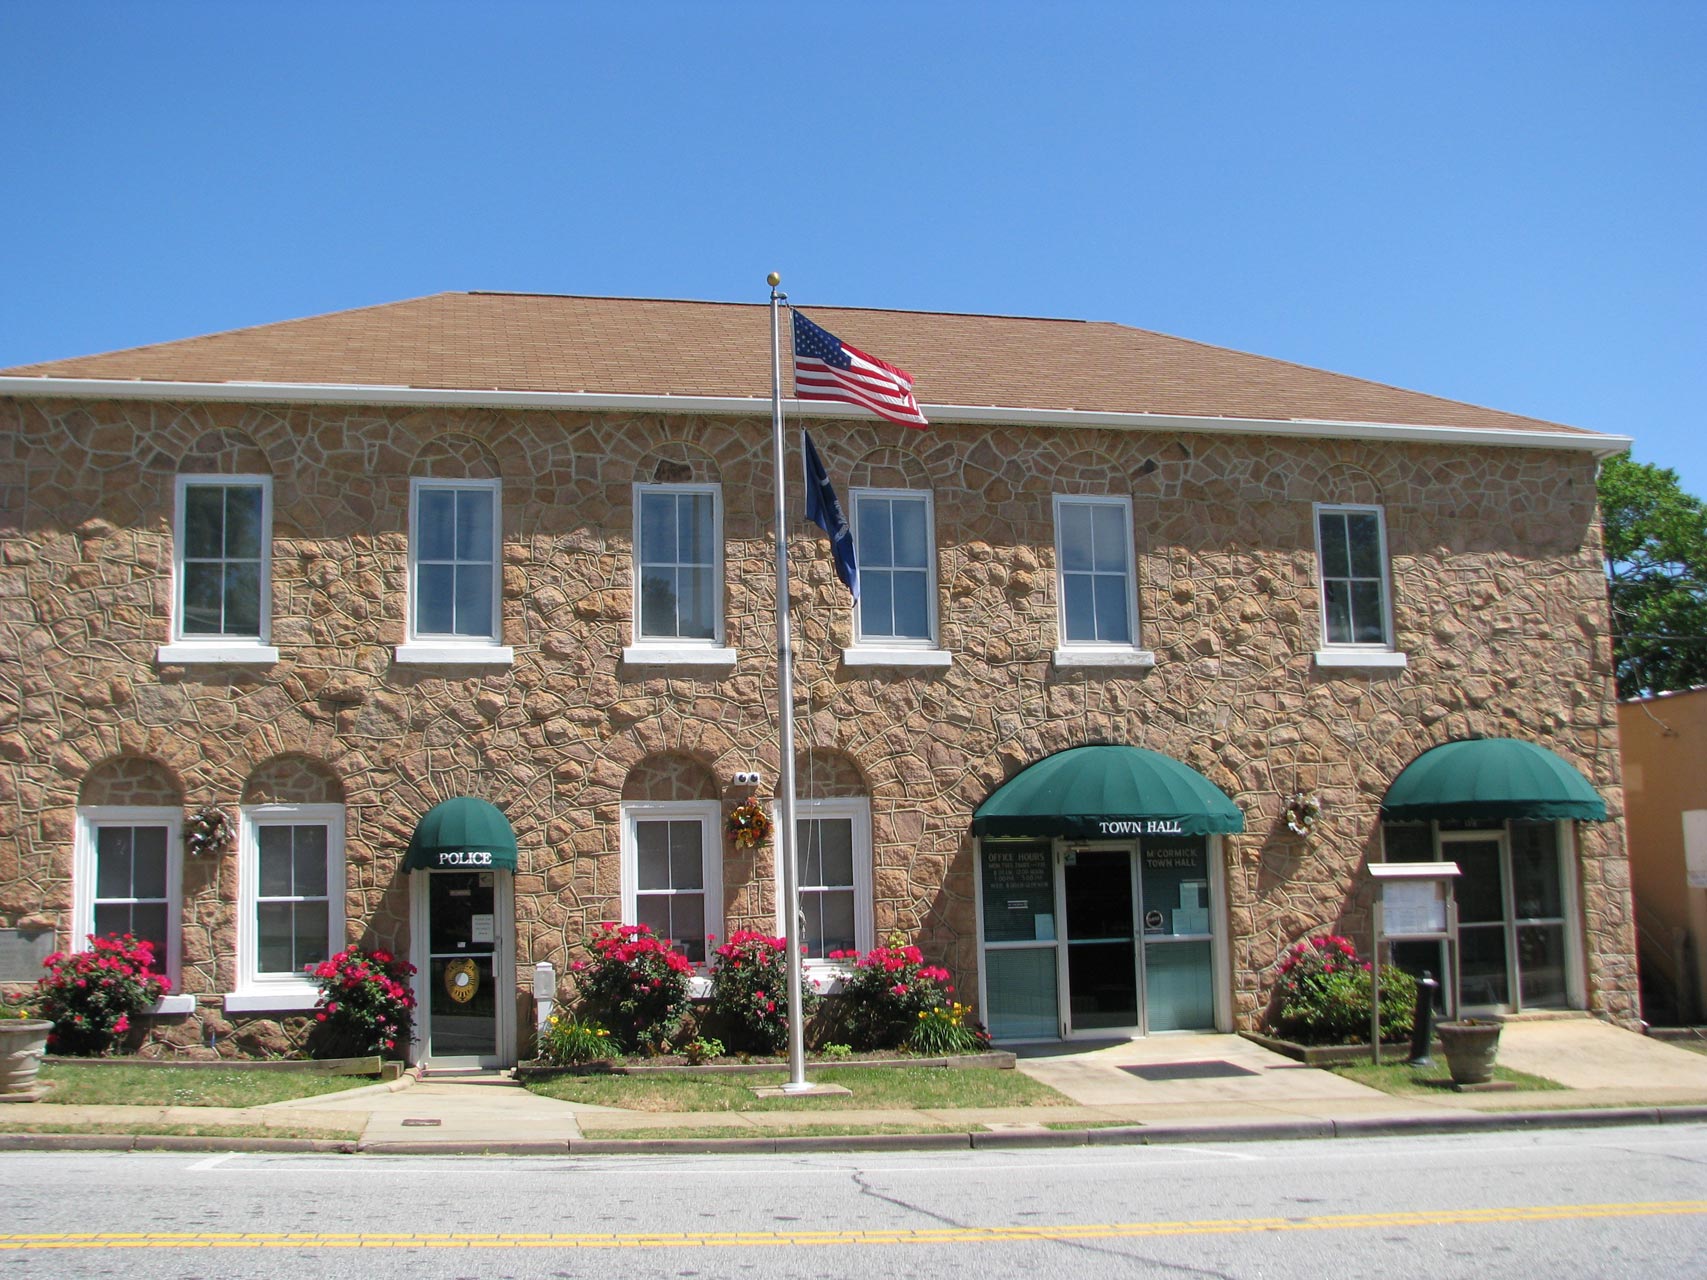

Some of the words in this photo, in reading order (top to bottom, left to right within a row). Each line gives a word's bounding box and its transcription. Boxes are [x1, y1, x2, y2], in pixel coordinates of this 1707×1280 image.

[1099, 821, 1141, 833] TOWN
[1147, 820, 1182, 833] HALL
[439, 852, 492, 865] POLICE
[1157, 848, 1198, 858] CORMICK
[1146, 858, 1173, 868] TOWN
[1174, 858, 1197, 868] HALL
